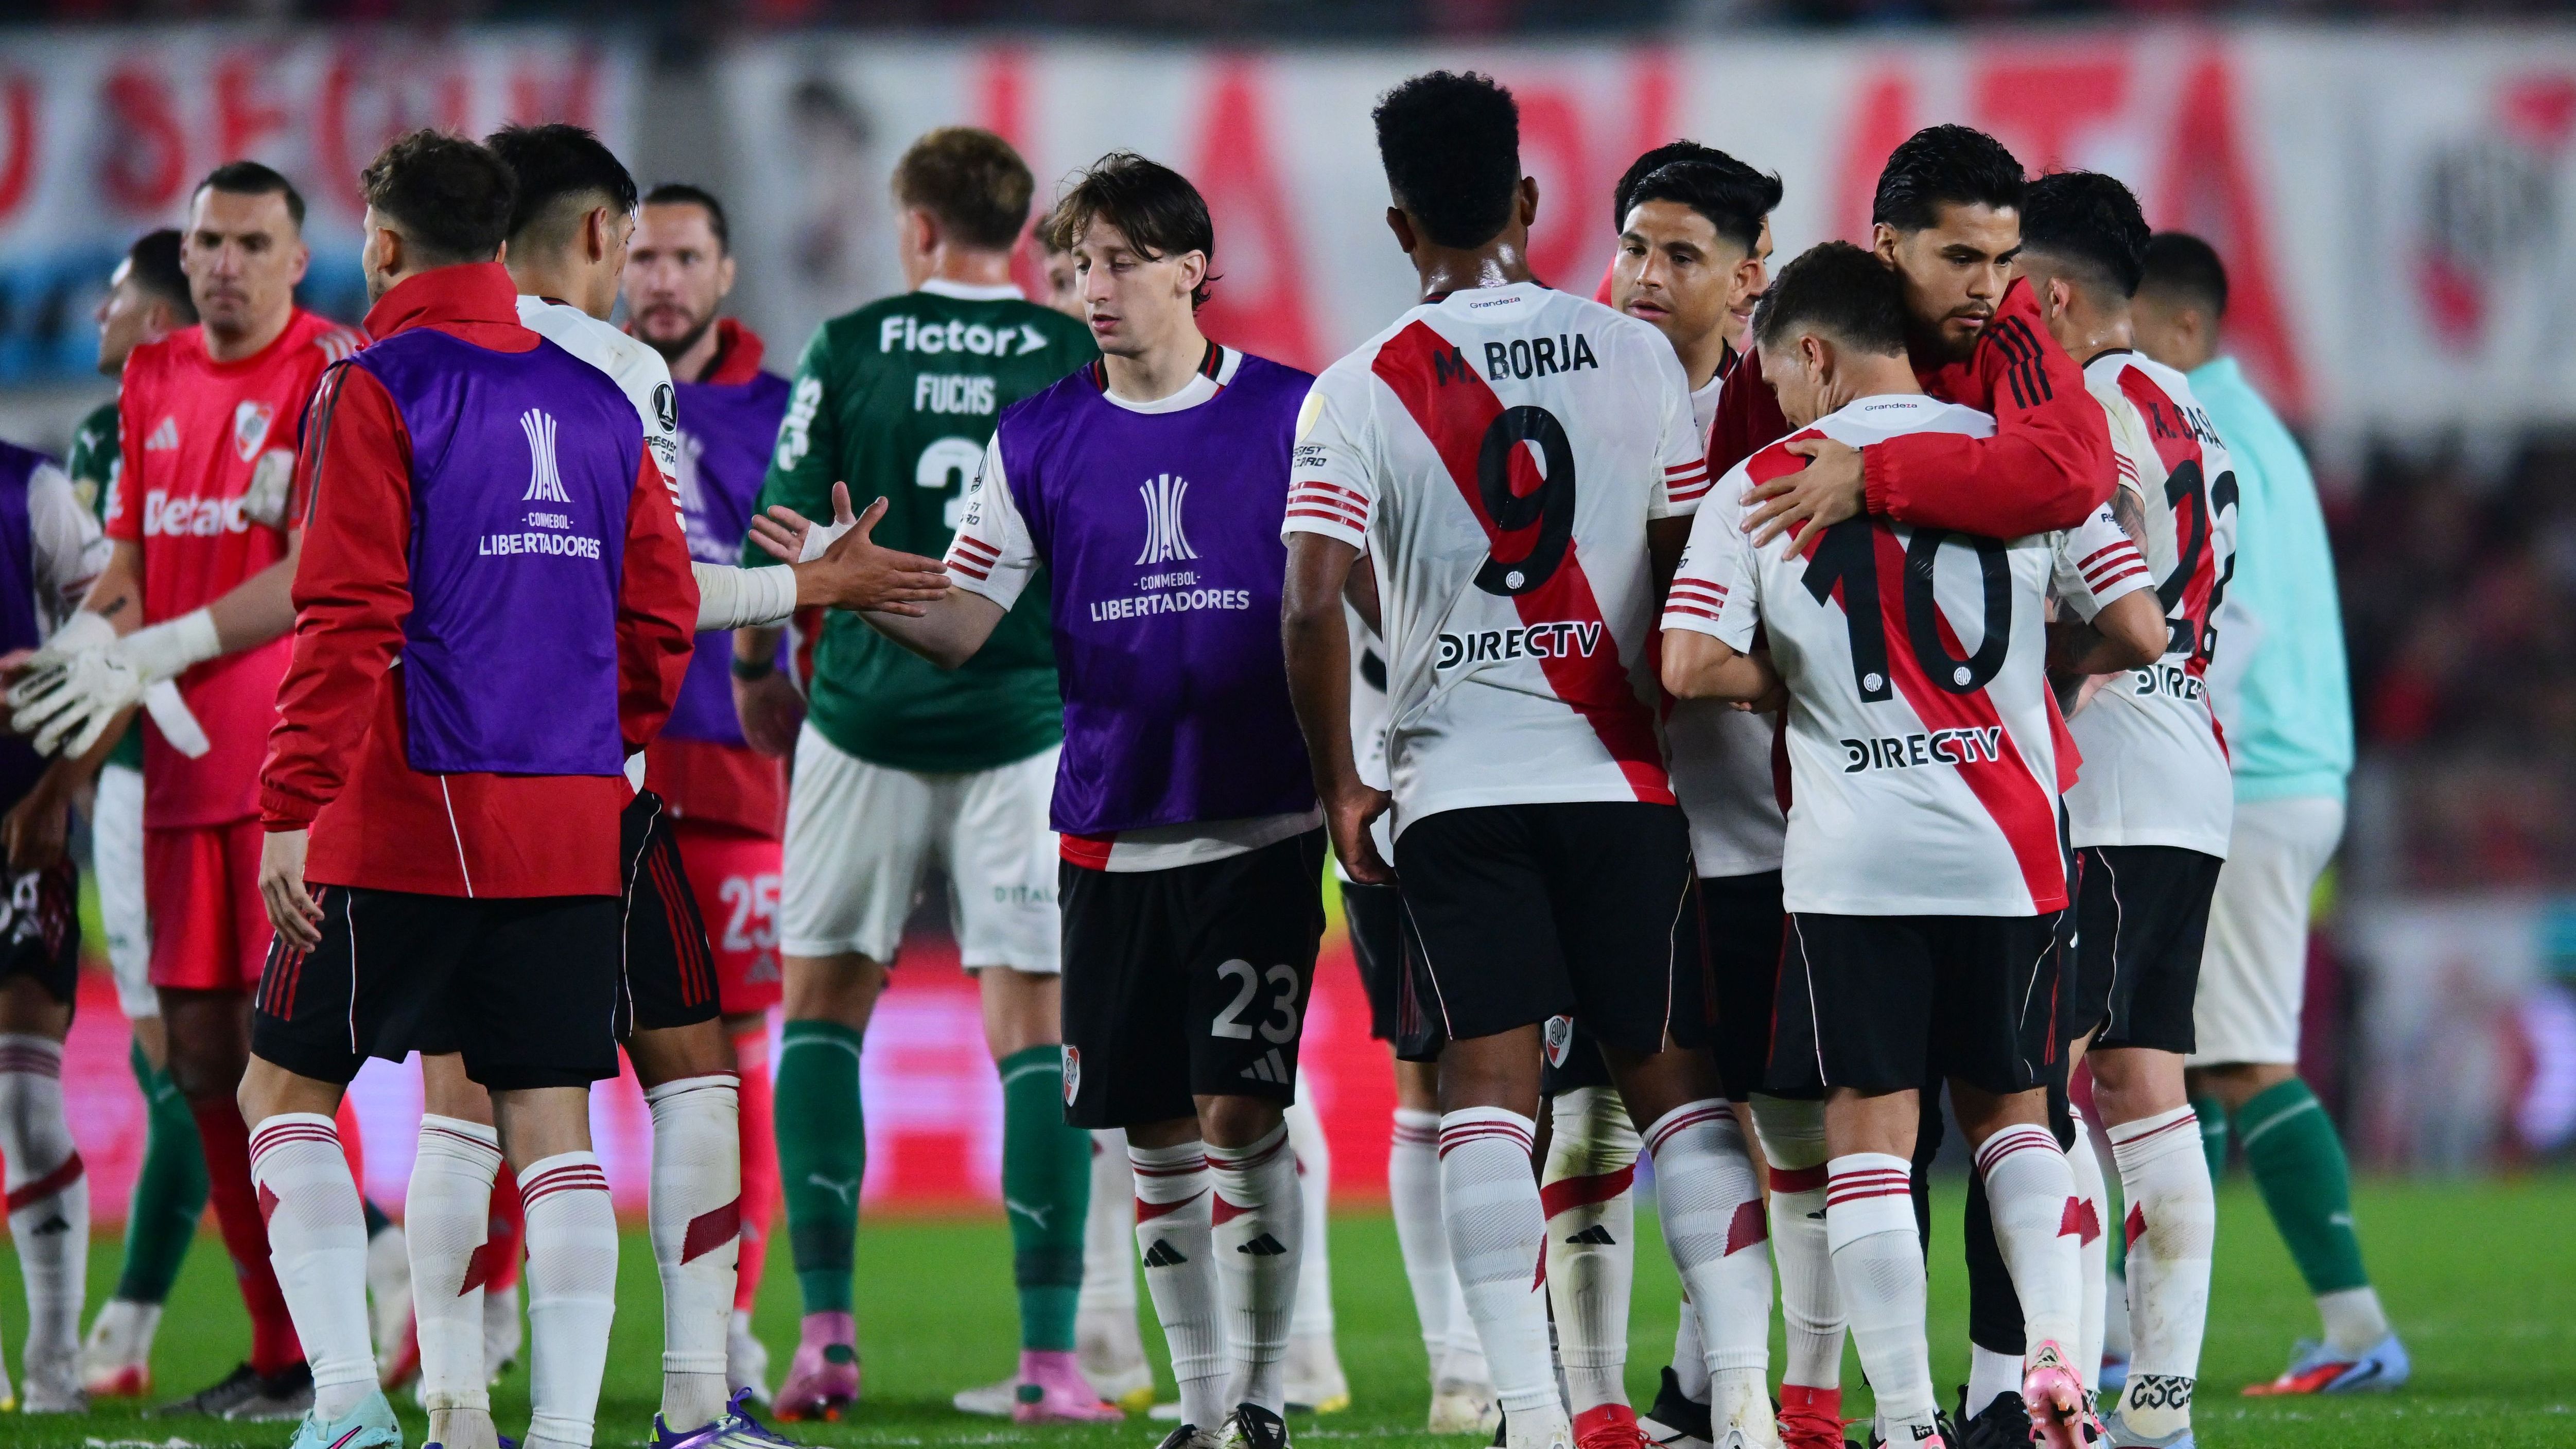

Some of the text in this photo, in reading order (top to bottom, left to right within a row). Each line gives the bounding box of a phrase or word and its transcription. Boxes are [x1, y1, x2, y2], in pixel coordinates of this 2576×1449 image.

[1470, 296, 1521, 308] Grandeza
[879, 315, 1019, 357] Fictor
[1433, 334, 1599, 387] M. BORJA
[914, 373, 996, 415] FUCHS
[1865, 403, 1918, 411] Grandeza
[1473, 405, 1576, 597] 9
[479, 532, 601, 560] LIBERTADORES
[1090, 589, 1250, 622] LIBERTADORES
[1801, 516, 2012, 703] 10
[1435, 621, 1602, 671] DIRECTV
[1839, 726, 2001, 774] DIRECTV
[720, 875, 783, 951] 25
[1211, 958, 1299, 1044] 23
